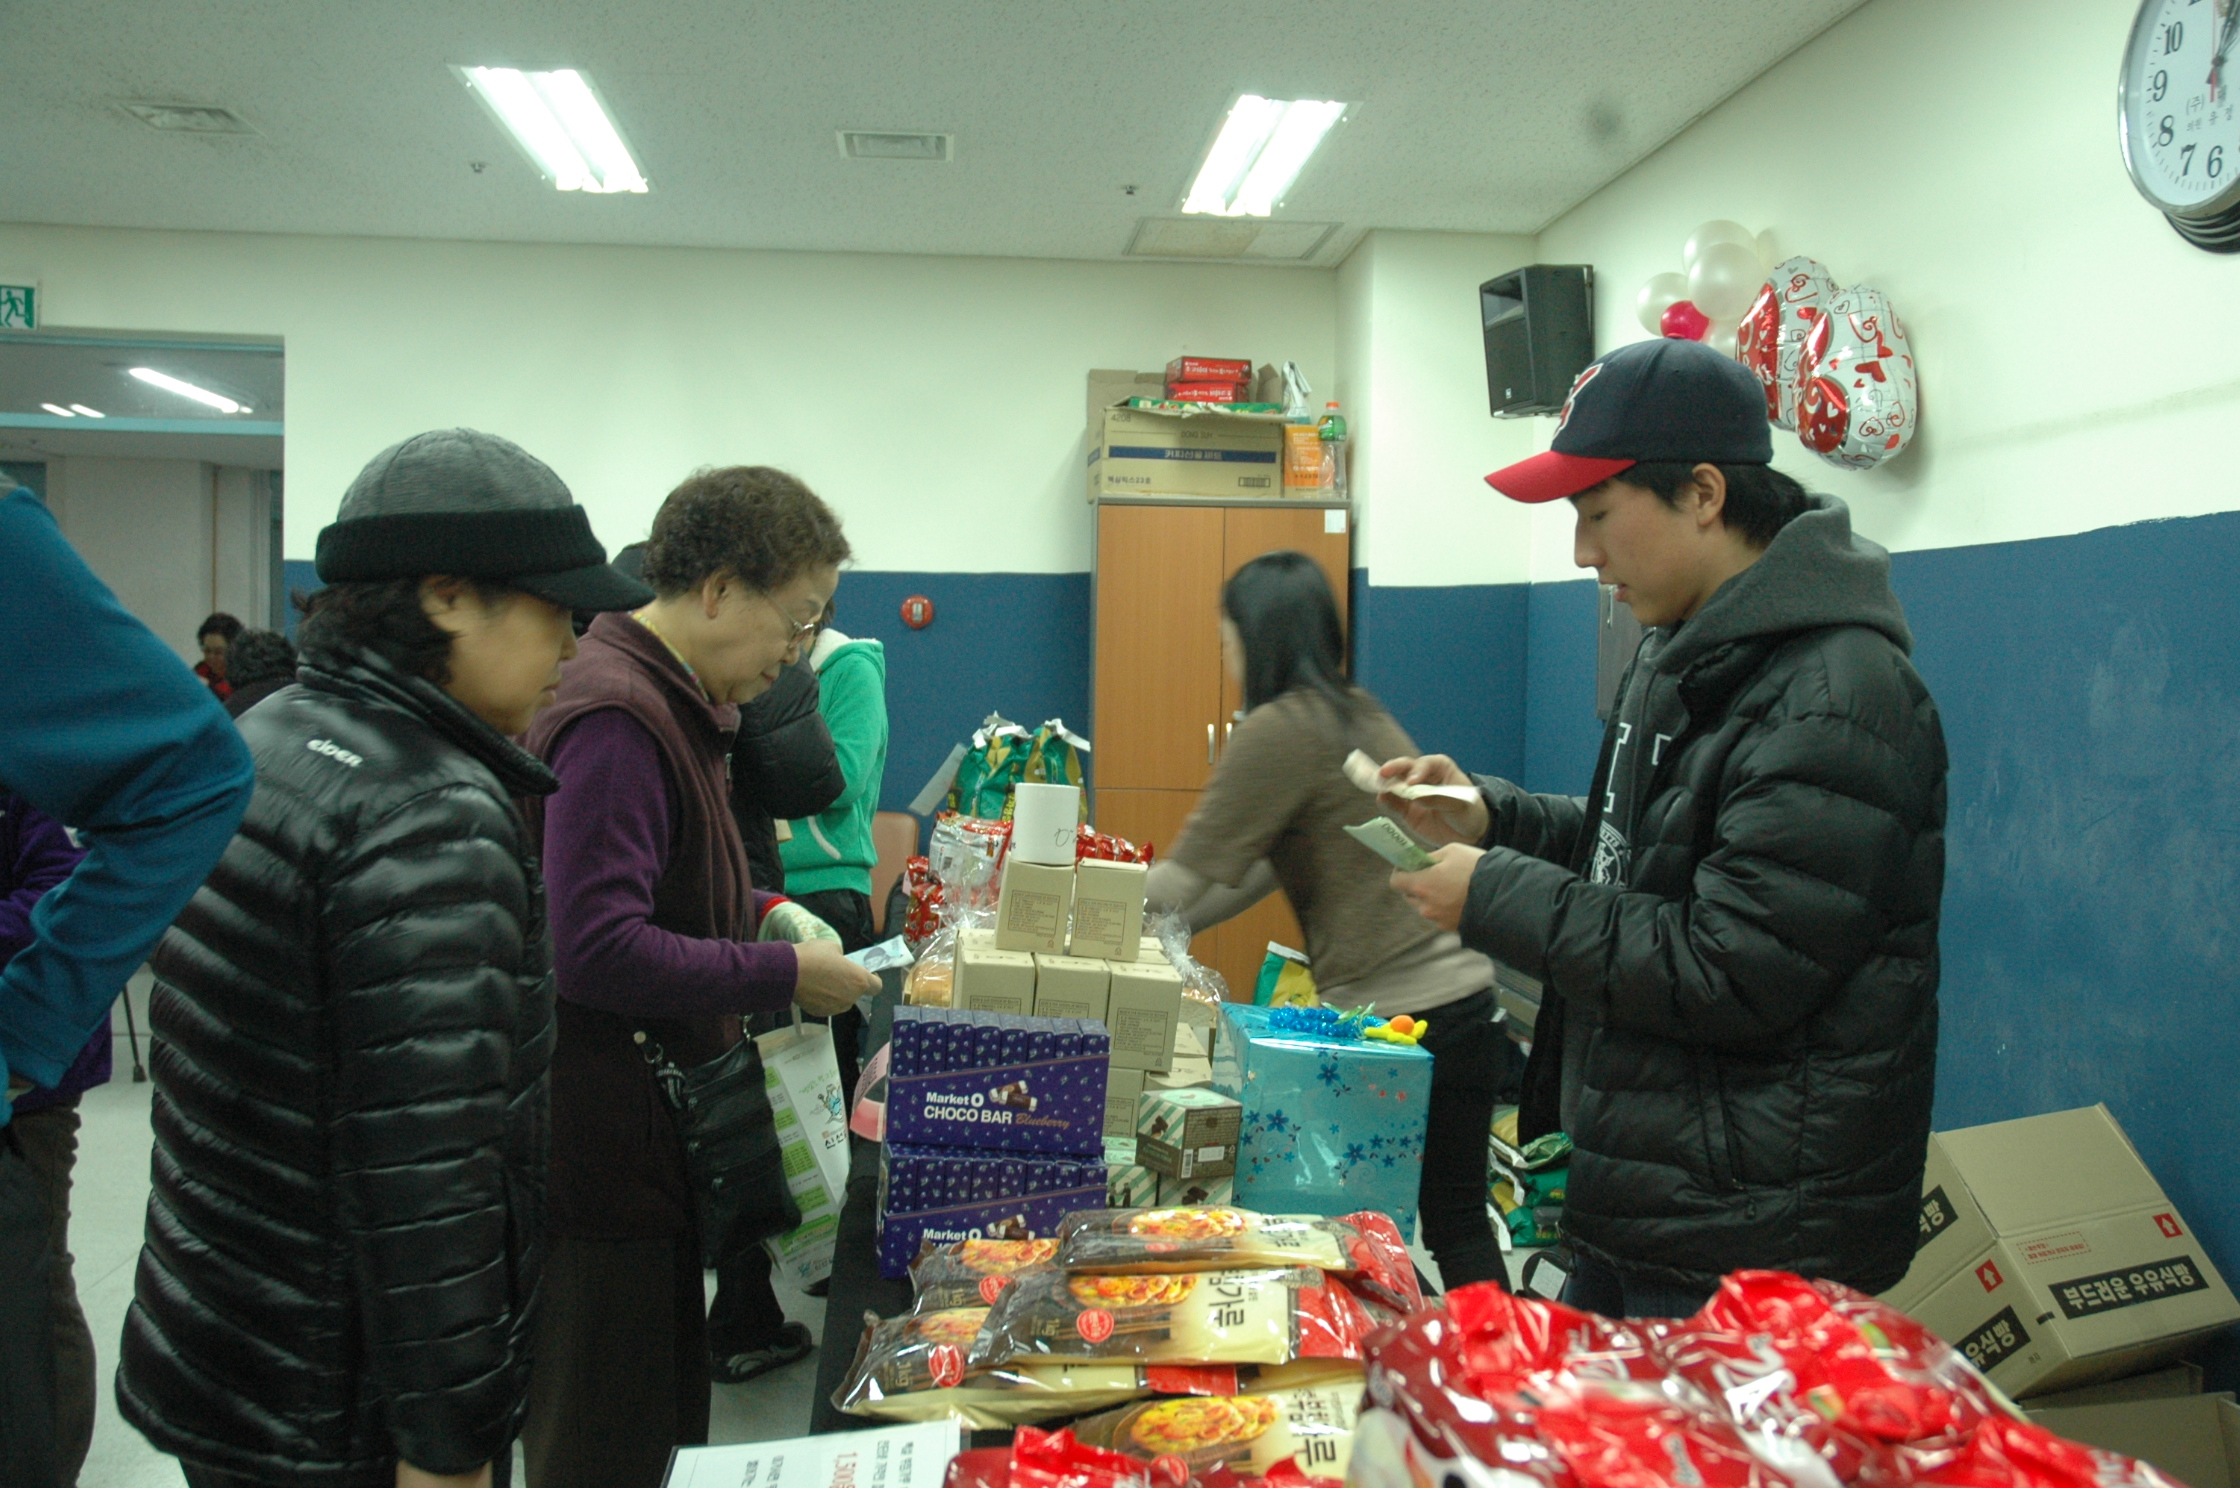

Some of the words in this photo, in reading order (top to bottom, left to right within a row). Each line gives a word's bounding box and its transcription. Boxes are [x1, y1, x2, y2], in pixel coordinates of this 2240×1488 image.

[2163, 21, 2183, 56] 10
[2152, 69, 2168, 102] 9
[2158, 115, 2174, 147] 8
[2180, 142, 2198, 177] 7
[2207, 145, 2224, 179] 6
[1110, 413, 1132, 423] 4208
[926, 1092, 970, 1106] Market
[971, 1093, 984, 1107] O
[924, 1105, 978, 1123] CHOCO
[981, 1109, 1013, 1124] BAR
[1015, 1113, 1071, 1130] Blueberry
[923, 1228, 967, 1241] Market
[968, 1228, 982, 1241] O
[2062, 1276, 2132, 1310] 부드러운
[2132, 1263, 2196, 1295] 우유식빵
[1040, 1318, 1061, 1337] 1kg
[894, 1361, 913, 1388] 1kg
